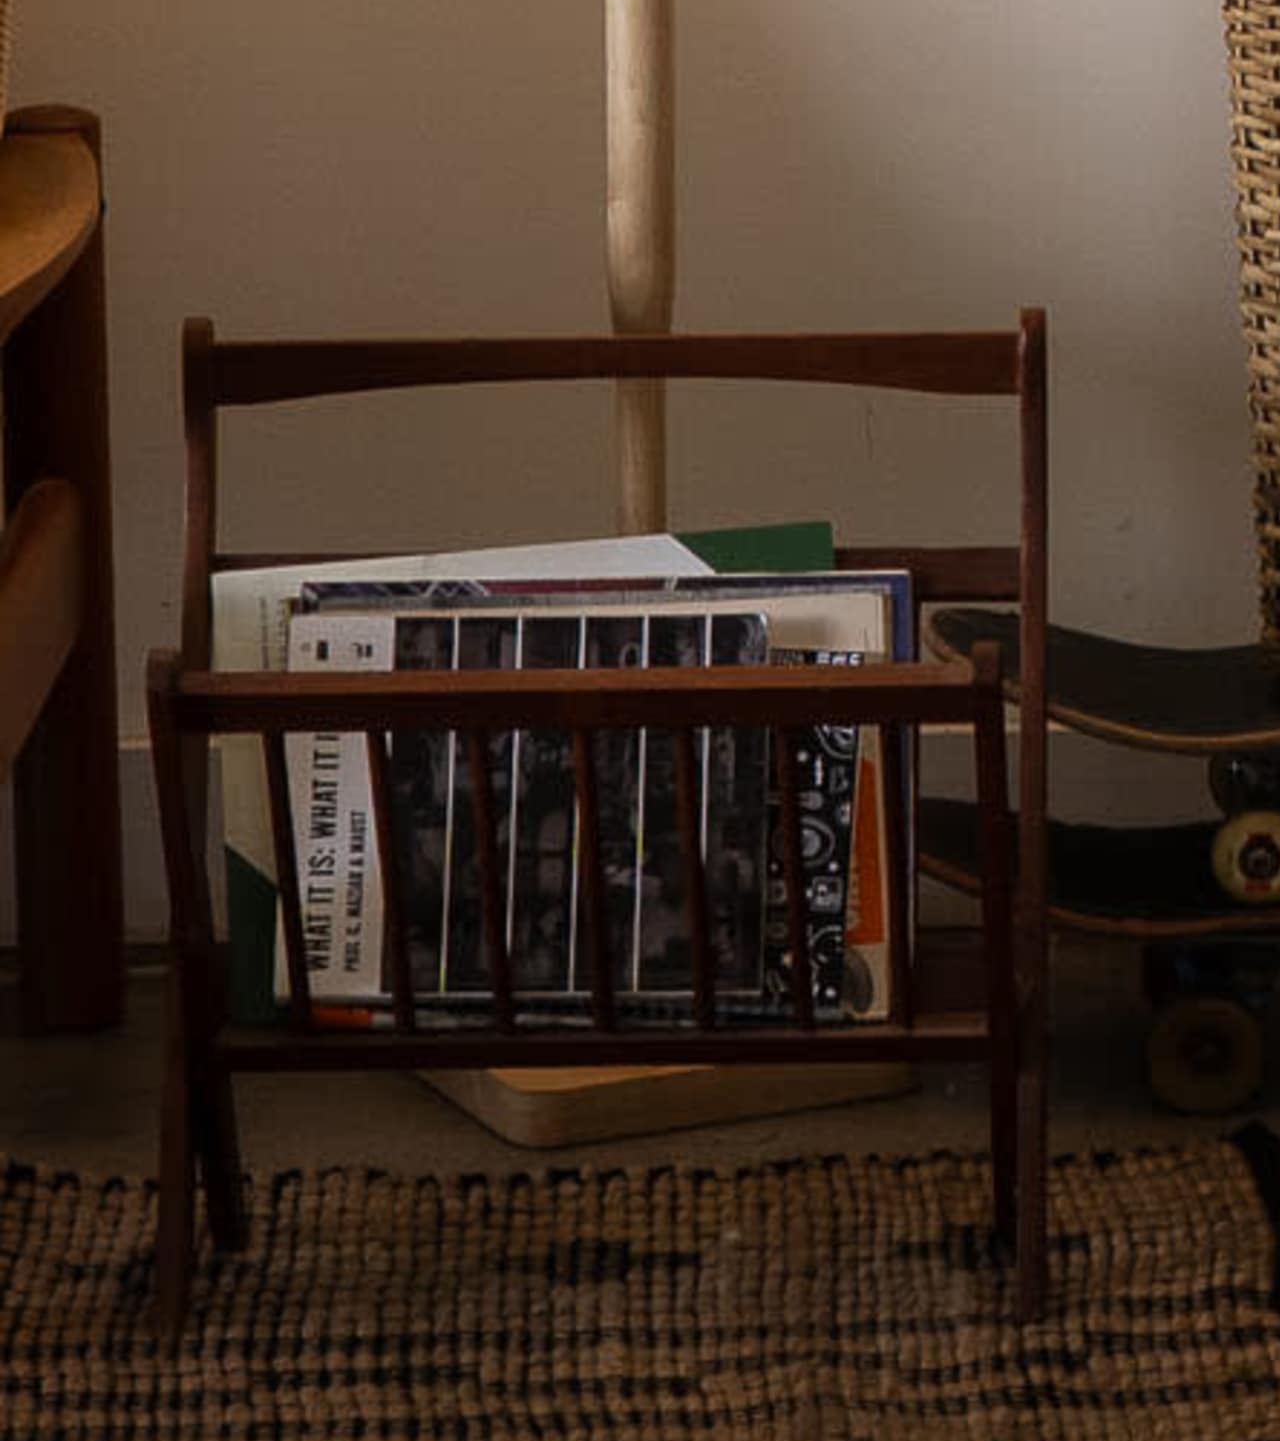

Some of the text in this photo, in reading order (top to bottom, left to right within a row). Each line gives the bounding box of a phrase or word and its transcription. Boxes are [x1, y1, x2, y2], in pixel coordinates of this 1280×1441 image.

[312, 749, 340, 770] IT
[309, 779, 339, 840] WHAT
[307, 847, 336, 878] IS:
[306, 885, 335, 905] IT
[304, 913, 333, 971] WHAT
